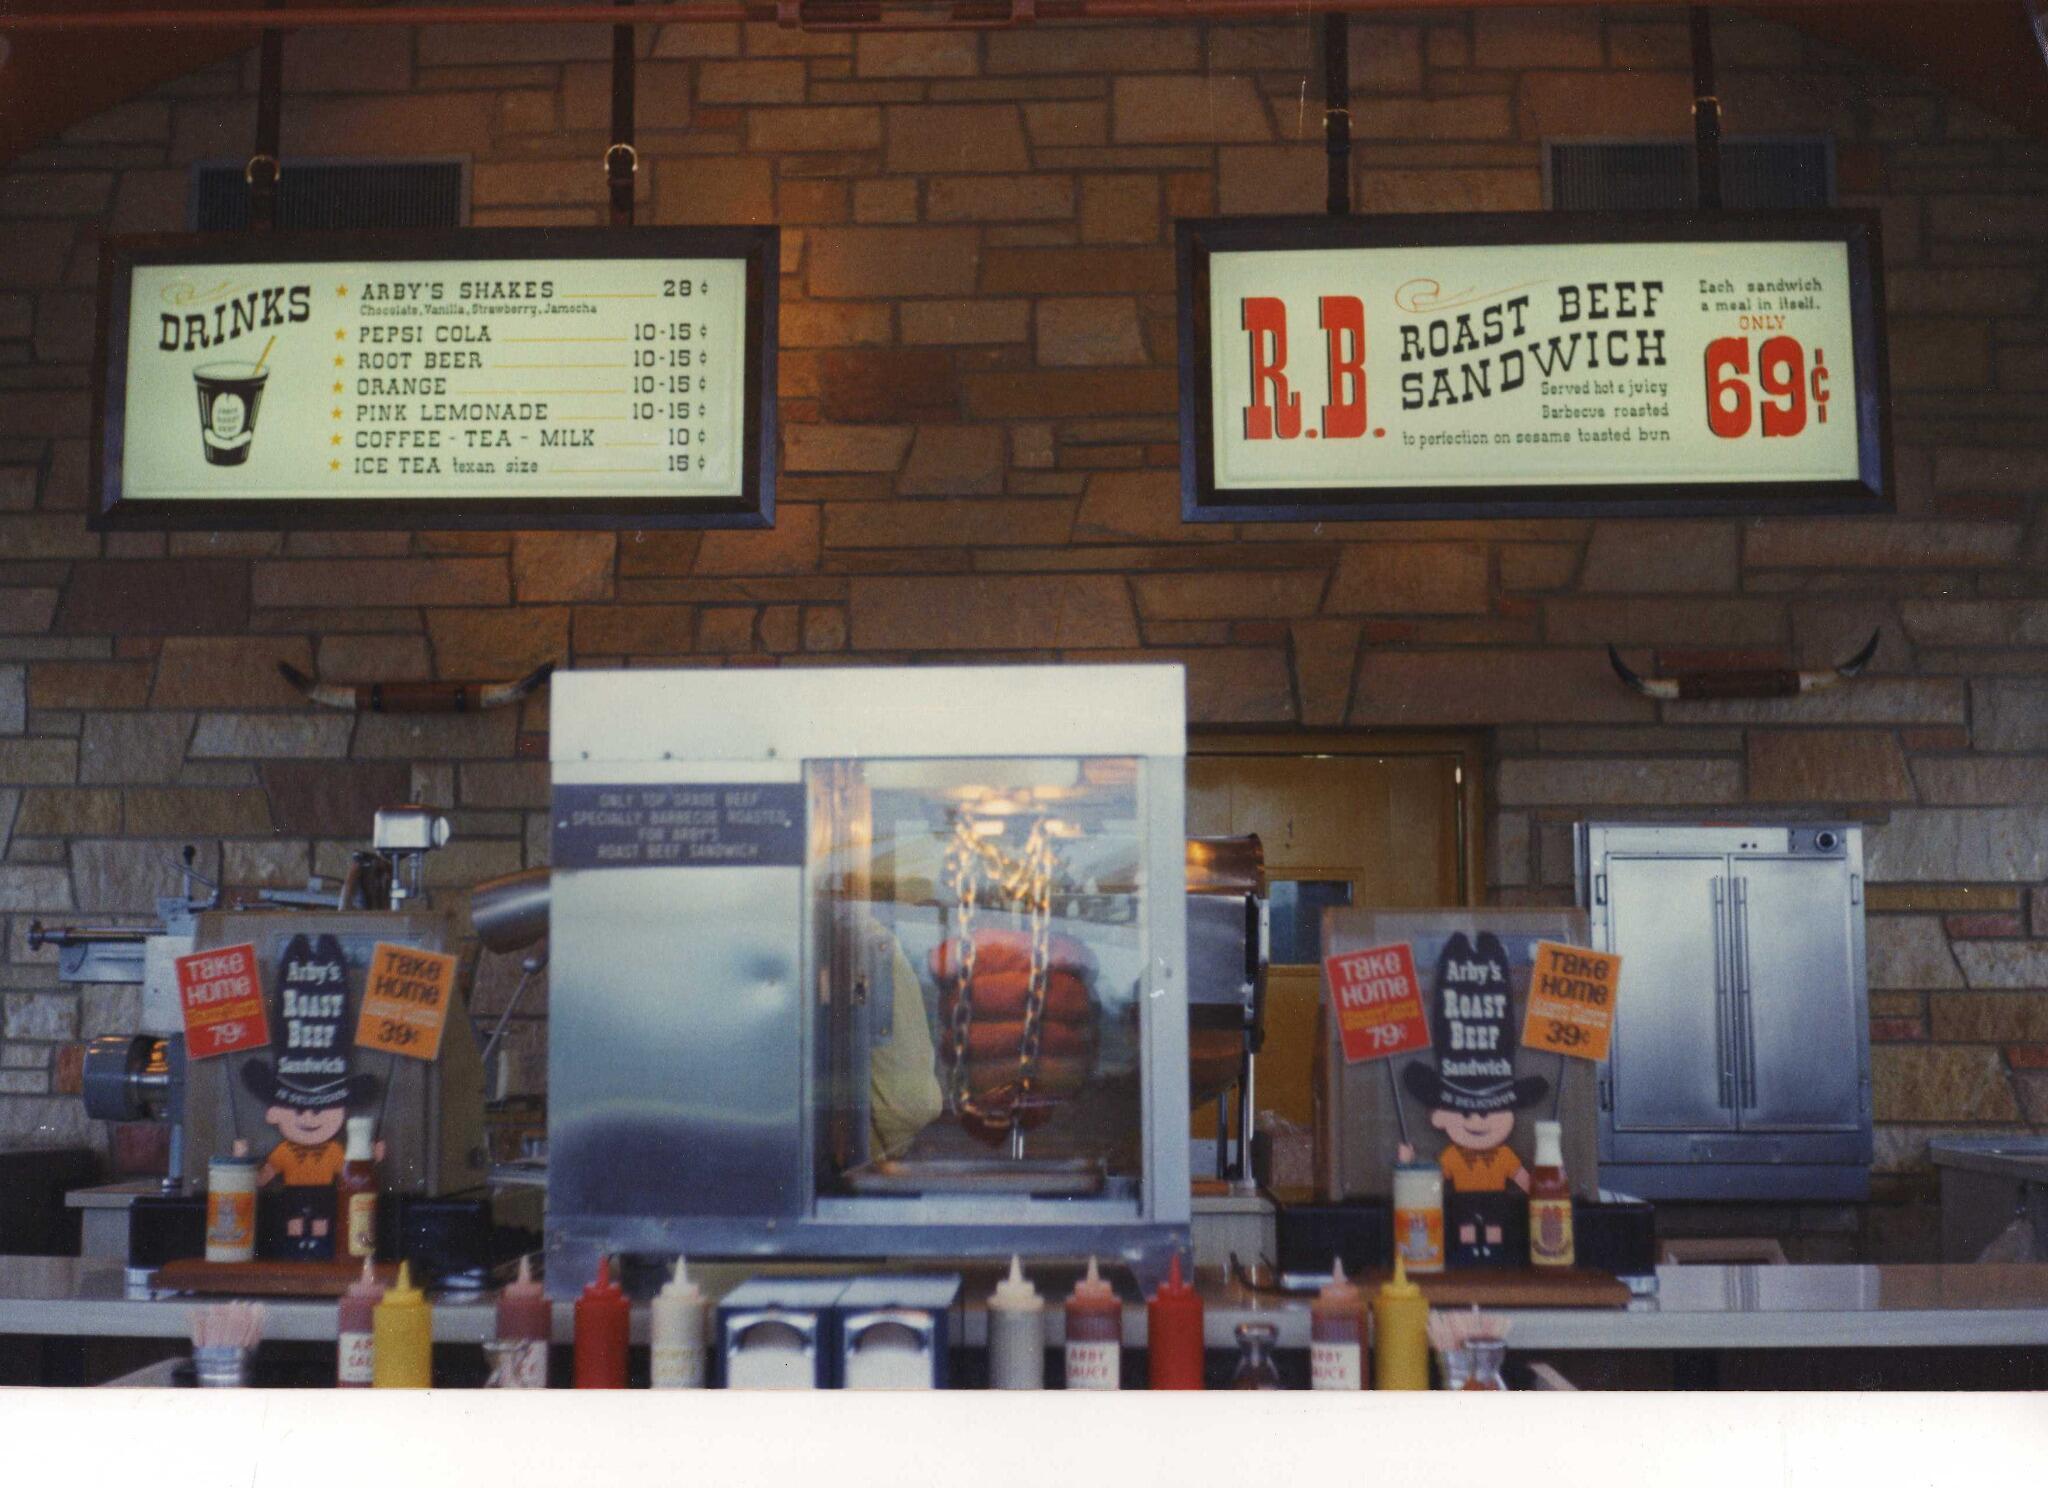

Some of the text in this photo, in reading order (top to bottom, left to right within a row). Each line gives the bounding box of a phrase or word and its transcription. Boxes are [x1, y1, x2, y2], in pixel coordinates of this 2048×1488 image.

[361, 283, 444, 300] ARBY'S
[459, 281, 554, 299] SHAKES
[663, 279, 692, 297] 28
[1699, 278, 1822, 294] Each sandwich
[1701, 302, 1709, 312] a
[1716, 298, 1751, 311] meal
[1758, 297, 1772, 310] in
[159, 285, 310, 351] DRINKS
[1400, 281, 1663, 362] ROAST BEEF
[1739, 315, 1786, 330] ONLY
[359, 326, 423, 343] PEPSI
[435, 325, 492, 343] COLA
[358, 352, 412, 369] ROOT
[424, 352, 483, 369] BEER
[1402, 330, 1667, 410] SANDWICH
[357, 378, 447, 396] ORANGE
[1541, 380, 1590, 396] Served
[1594, 381, 1614, 395] hot
[1629, 380, 1668, 397] juicy
[356, 404, 407, 421] PINK
[421, 403, 548, 421] LEMONADE
[1542, 402, 1669, 419] Barbecue roasted
[355, 430, 441, 448] COFFEE
[464, 430, 512, 447] TEA
[540, 429, 595, 447] MILK
[668, 428, 690, 446] 10
[1403, 427, 1670, 450] to perfection on sesame toasted bun
[354, 457, 388, 474] ICE
[399, 457, 441, 474] TEA
[452, 457, 495, 473] texan
[505, 457, 538, 473] size
[668, 455, 689, 472] 15
[286, 961, 341, 986] Arby's
[1447, 960, 1502, 986] Arby's
[278, 1056, 346, 1073] Sandwich
[1441, 1058, 1512, 1077] Sandwich
